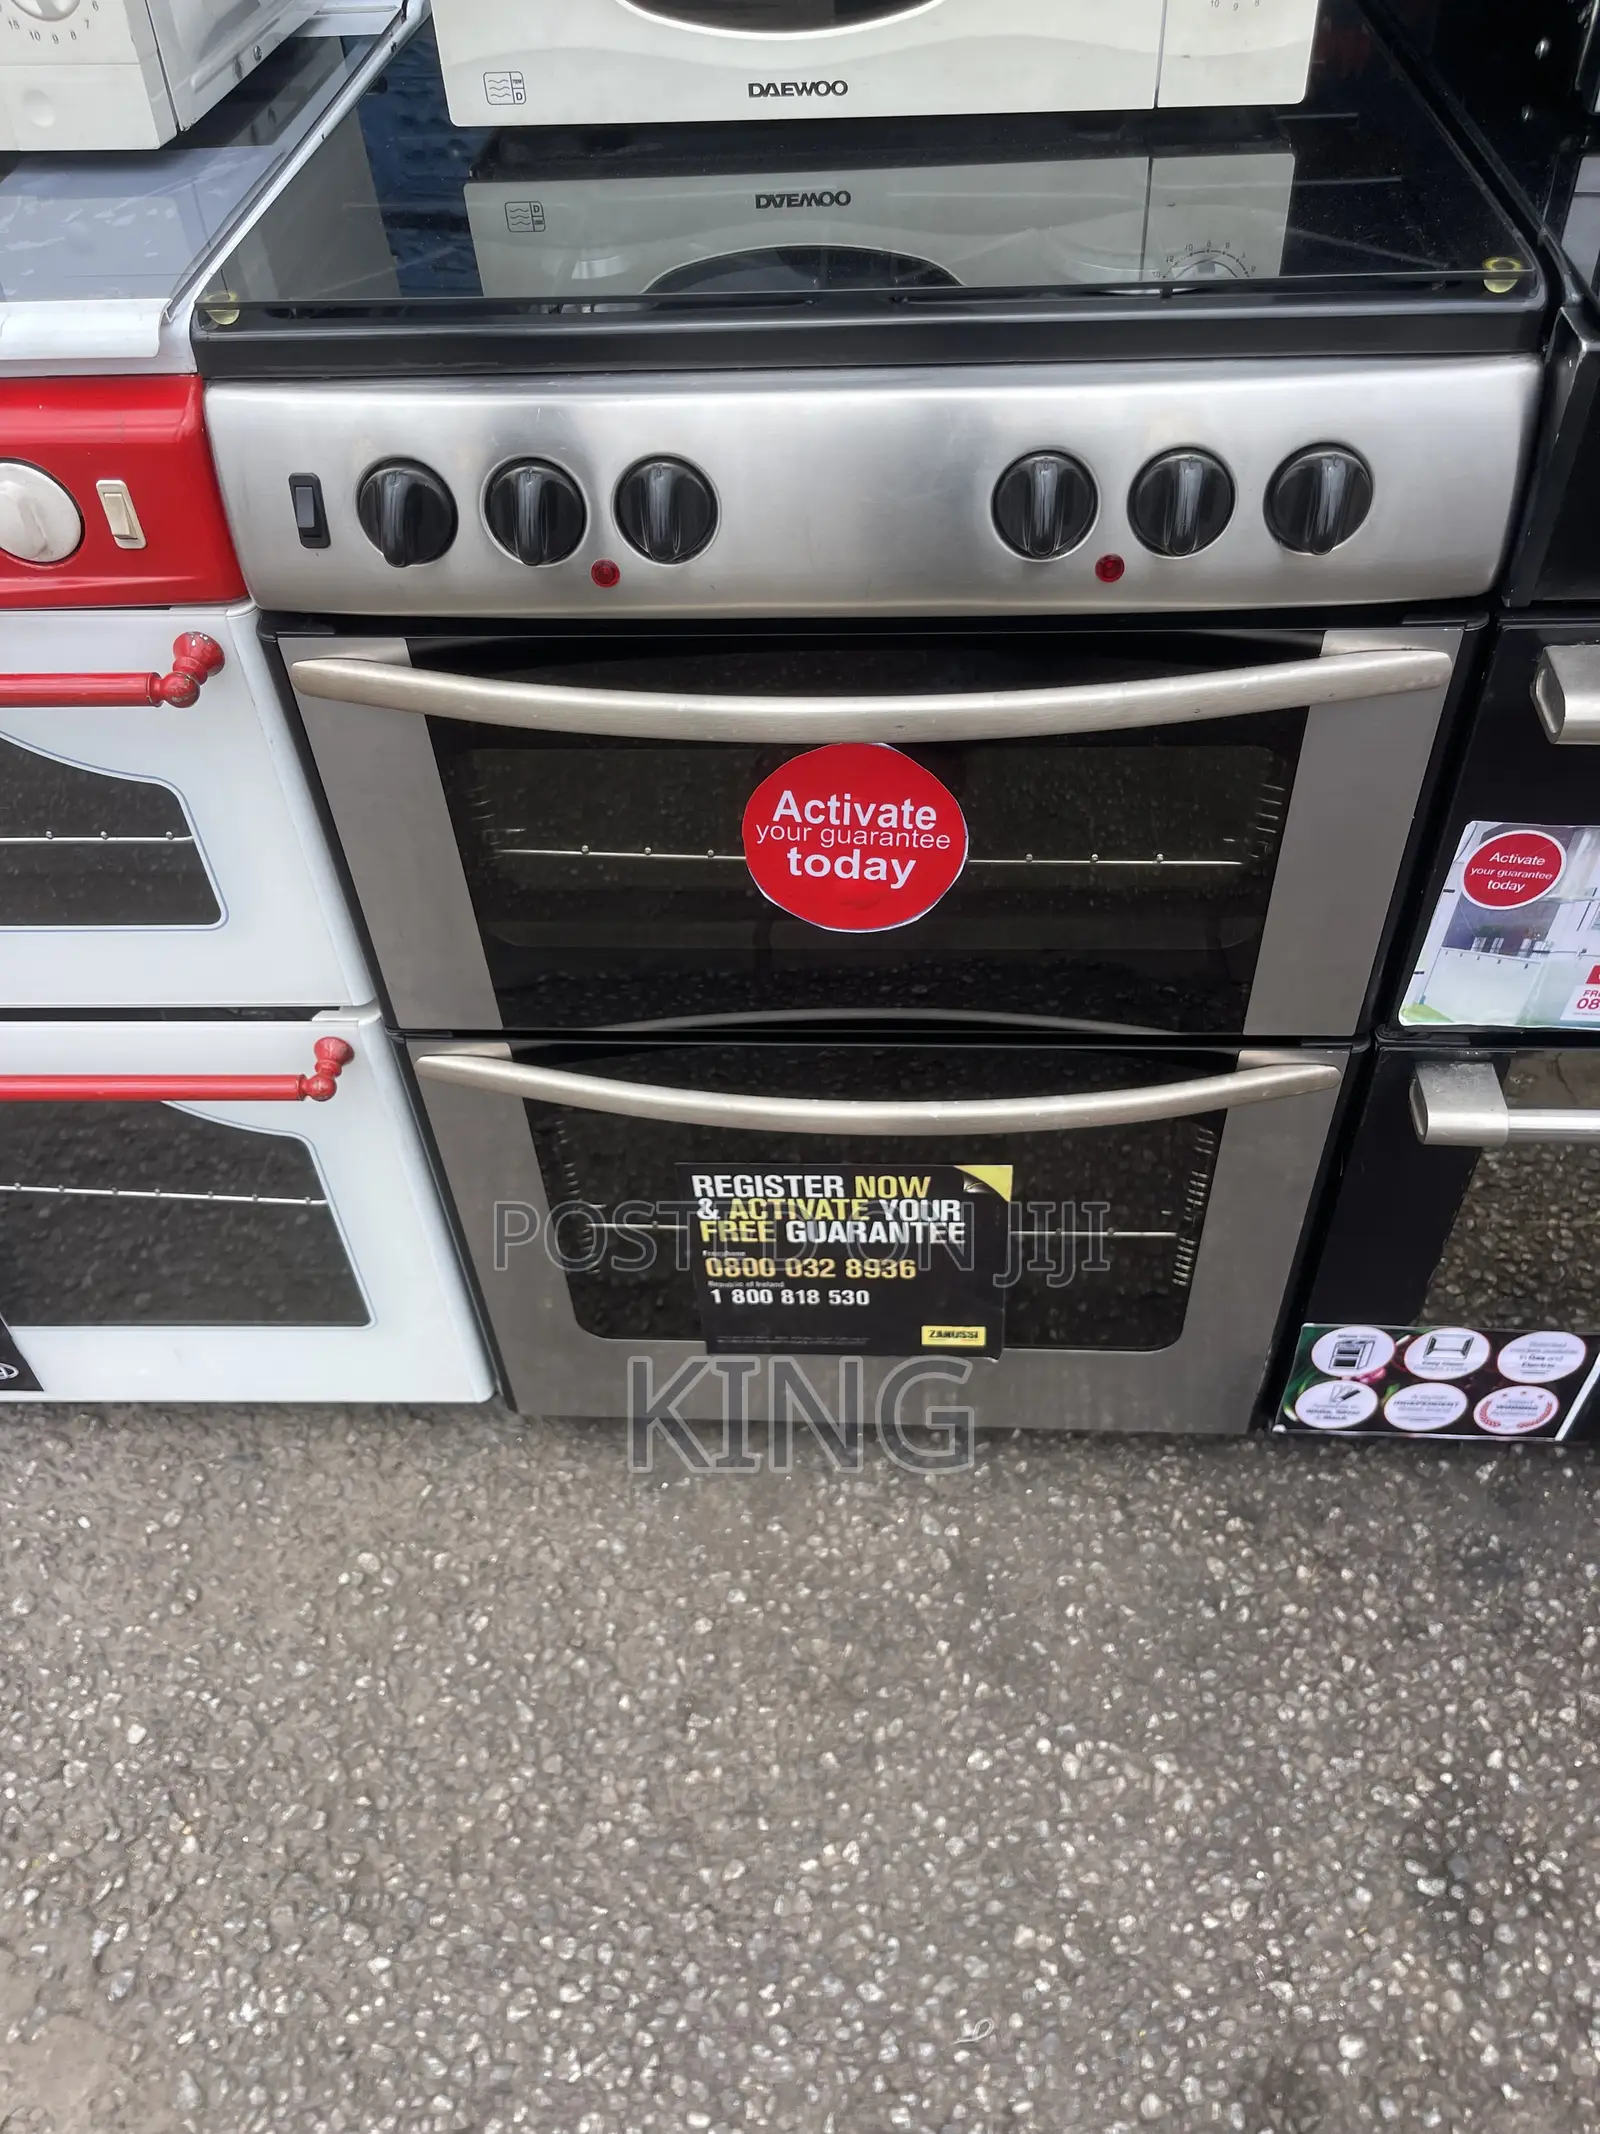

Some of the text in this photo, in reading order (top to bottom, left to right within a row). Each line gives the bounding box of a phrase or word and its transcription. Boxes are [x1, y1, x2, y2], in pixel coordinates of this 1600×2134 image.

[747, 80, 849, 99] DAEWOO
[772, 790, 937, 830] Activate
[756, 824, 951, 850] your guarantee
[786, 846, 917, 890] today
[1489, 851, 1546, 866] Activate
[1469, 866, 1553, 880] your guarantee
[1487, 879, 1526, 893] today
[691, 1175, 932, 1199] REGISTER NOW
[696, 1198, 962, 1222] & ACTIVATE YOUR
[701, 1221, 967, 1245] FREE GUARANTEE
[705, 1257, 917, 1280] 0800 032 8936
[710, 1288, 871, 1306] 1 800 818 530
[928, 1329, 979, 1339] ZANUSSI
